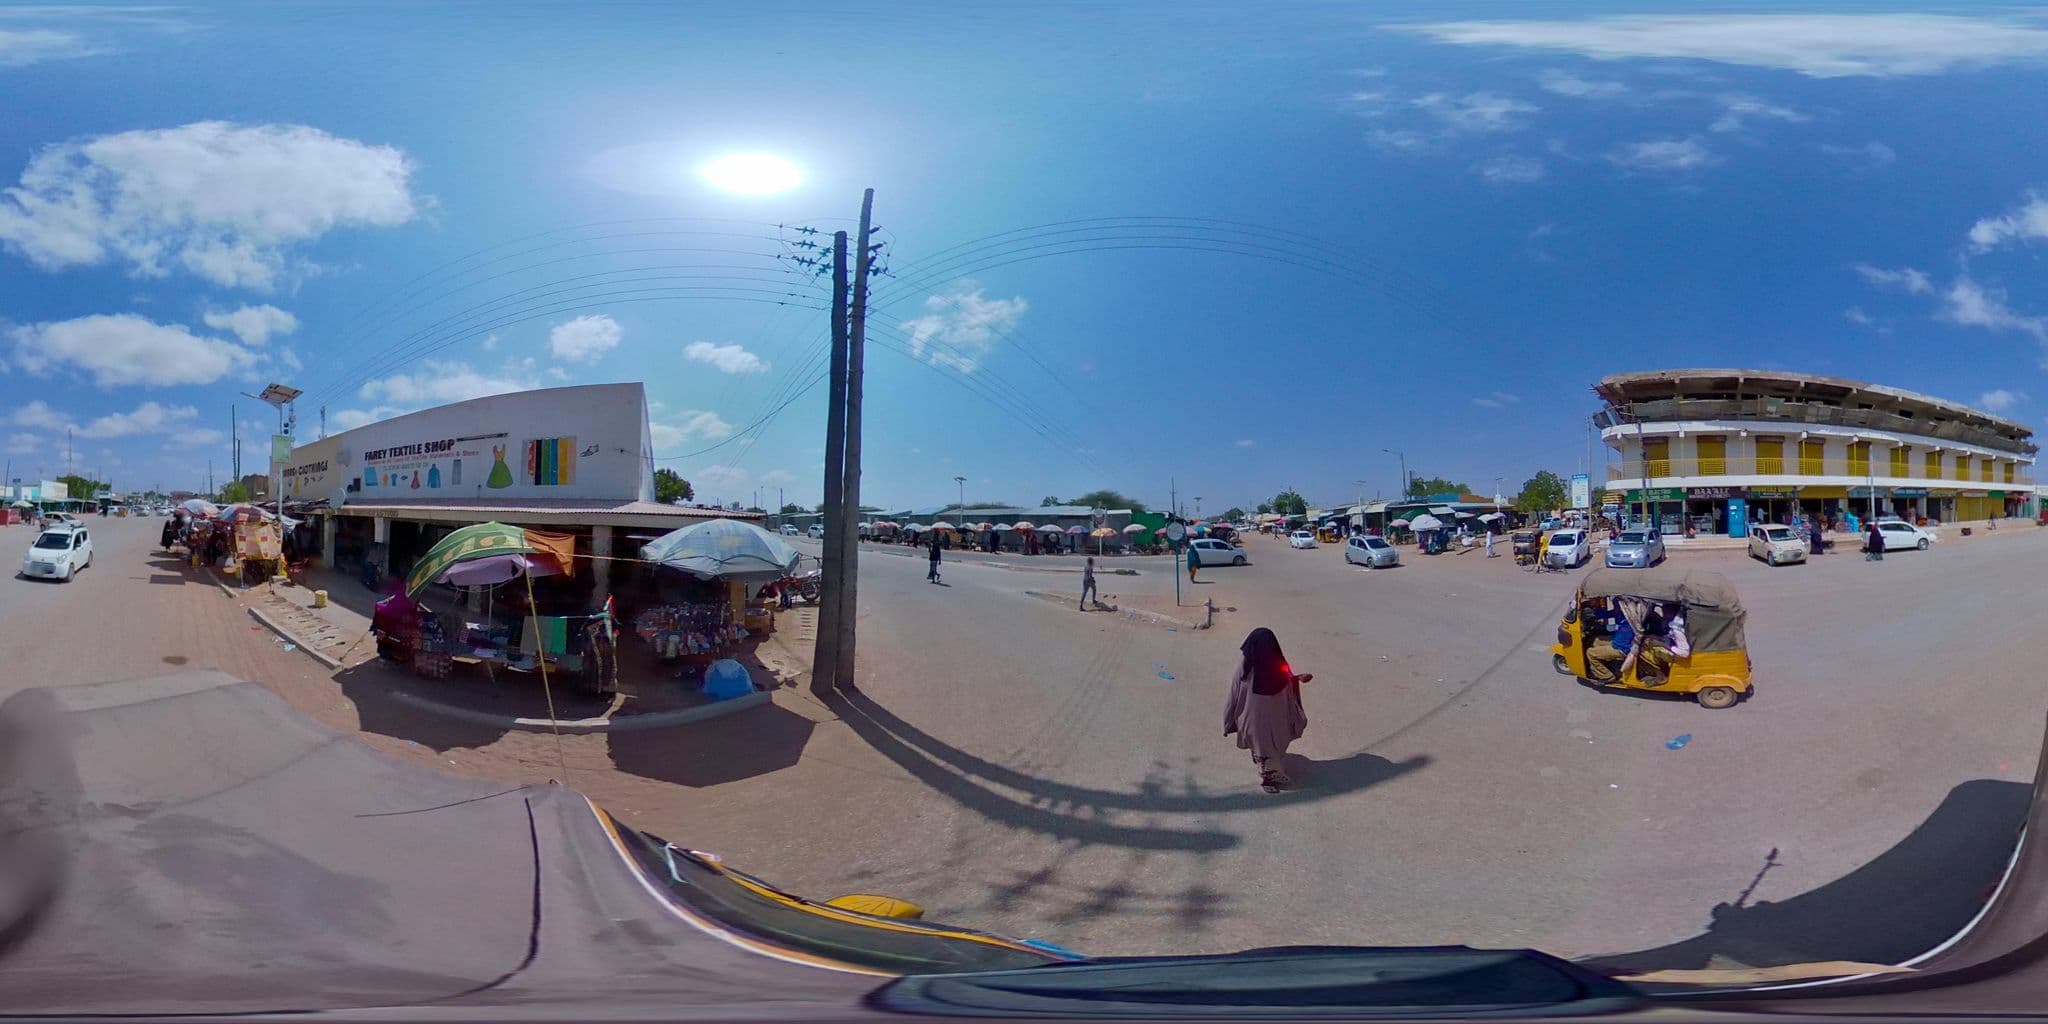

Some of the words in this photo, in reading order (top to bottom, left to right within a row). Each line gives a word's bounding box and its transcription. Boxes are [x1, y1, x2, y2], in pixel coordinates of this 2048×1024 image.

[364, 448, 387, 461] FAREY
[389, 443, 423, 458] TEXTILE
[424, 438, 455, 453] SHOP
